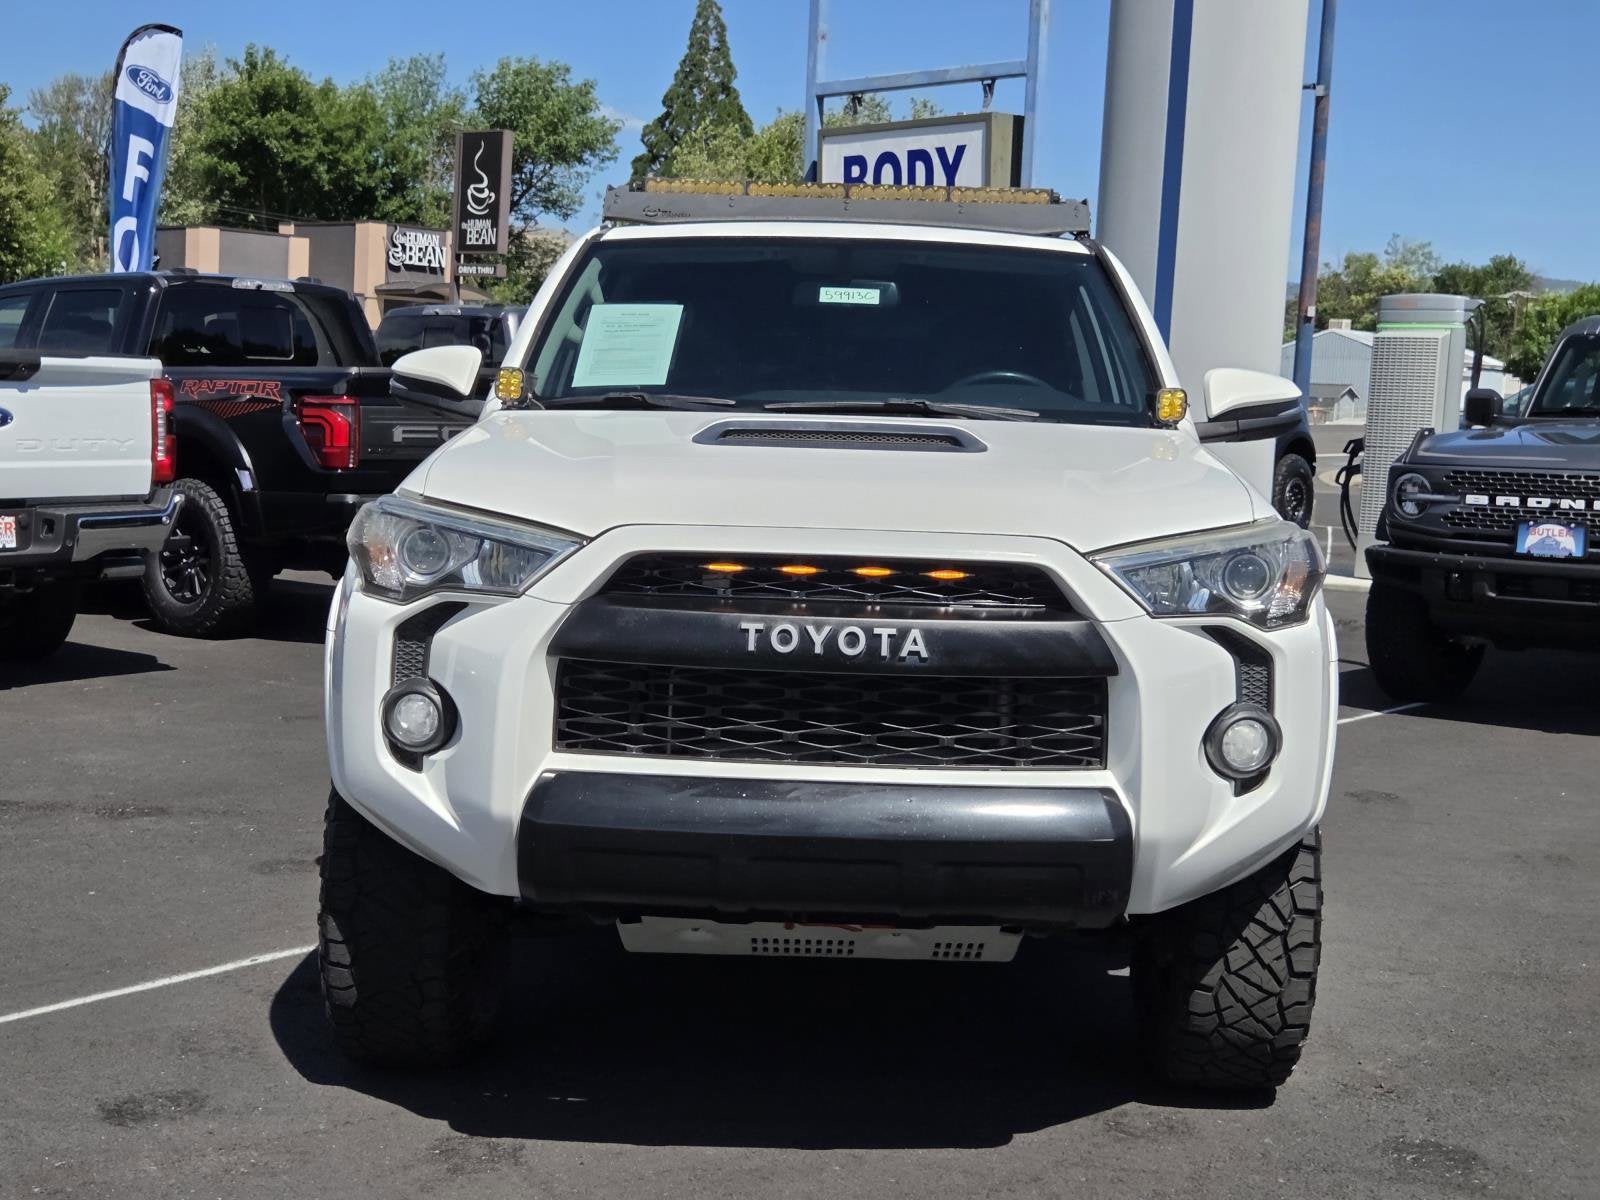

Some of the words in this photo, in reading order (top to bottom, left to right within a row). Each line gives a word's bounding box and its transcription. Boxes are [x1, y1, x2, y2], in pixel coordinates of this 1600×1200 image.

[137, 70, 164, 100] Ford
[843, 144, 967, 187] BODY
[467, 219, 492, 229] HUMAN
[405, 231, 440, 247] HUMAN
[466, 228, 497, 245] BEAN
[404, 244, 447, 268] BEAN
[458, 266, 477, 274] DRIVE
[477, 267, 495, 275] THRU
[179, 379, 282, 402] RAPTOR
[15, 437, 136, 453] DUTY
[1465, 494, 1600, 511] BRON
[740, 622, 929, 658] TOYOTA
